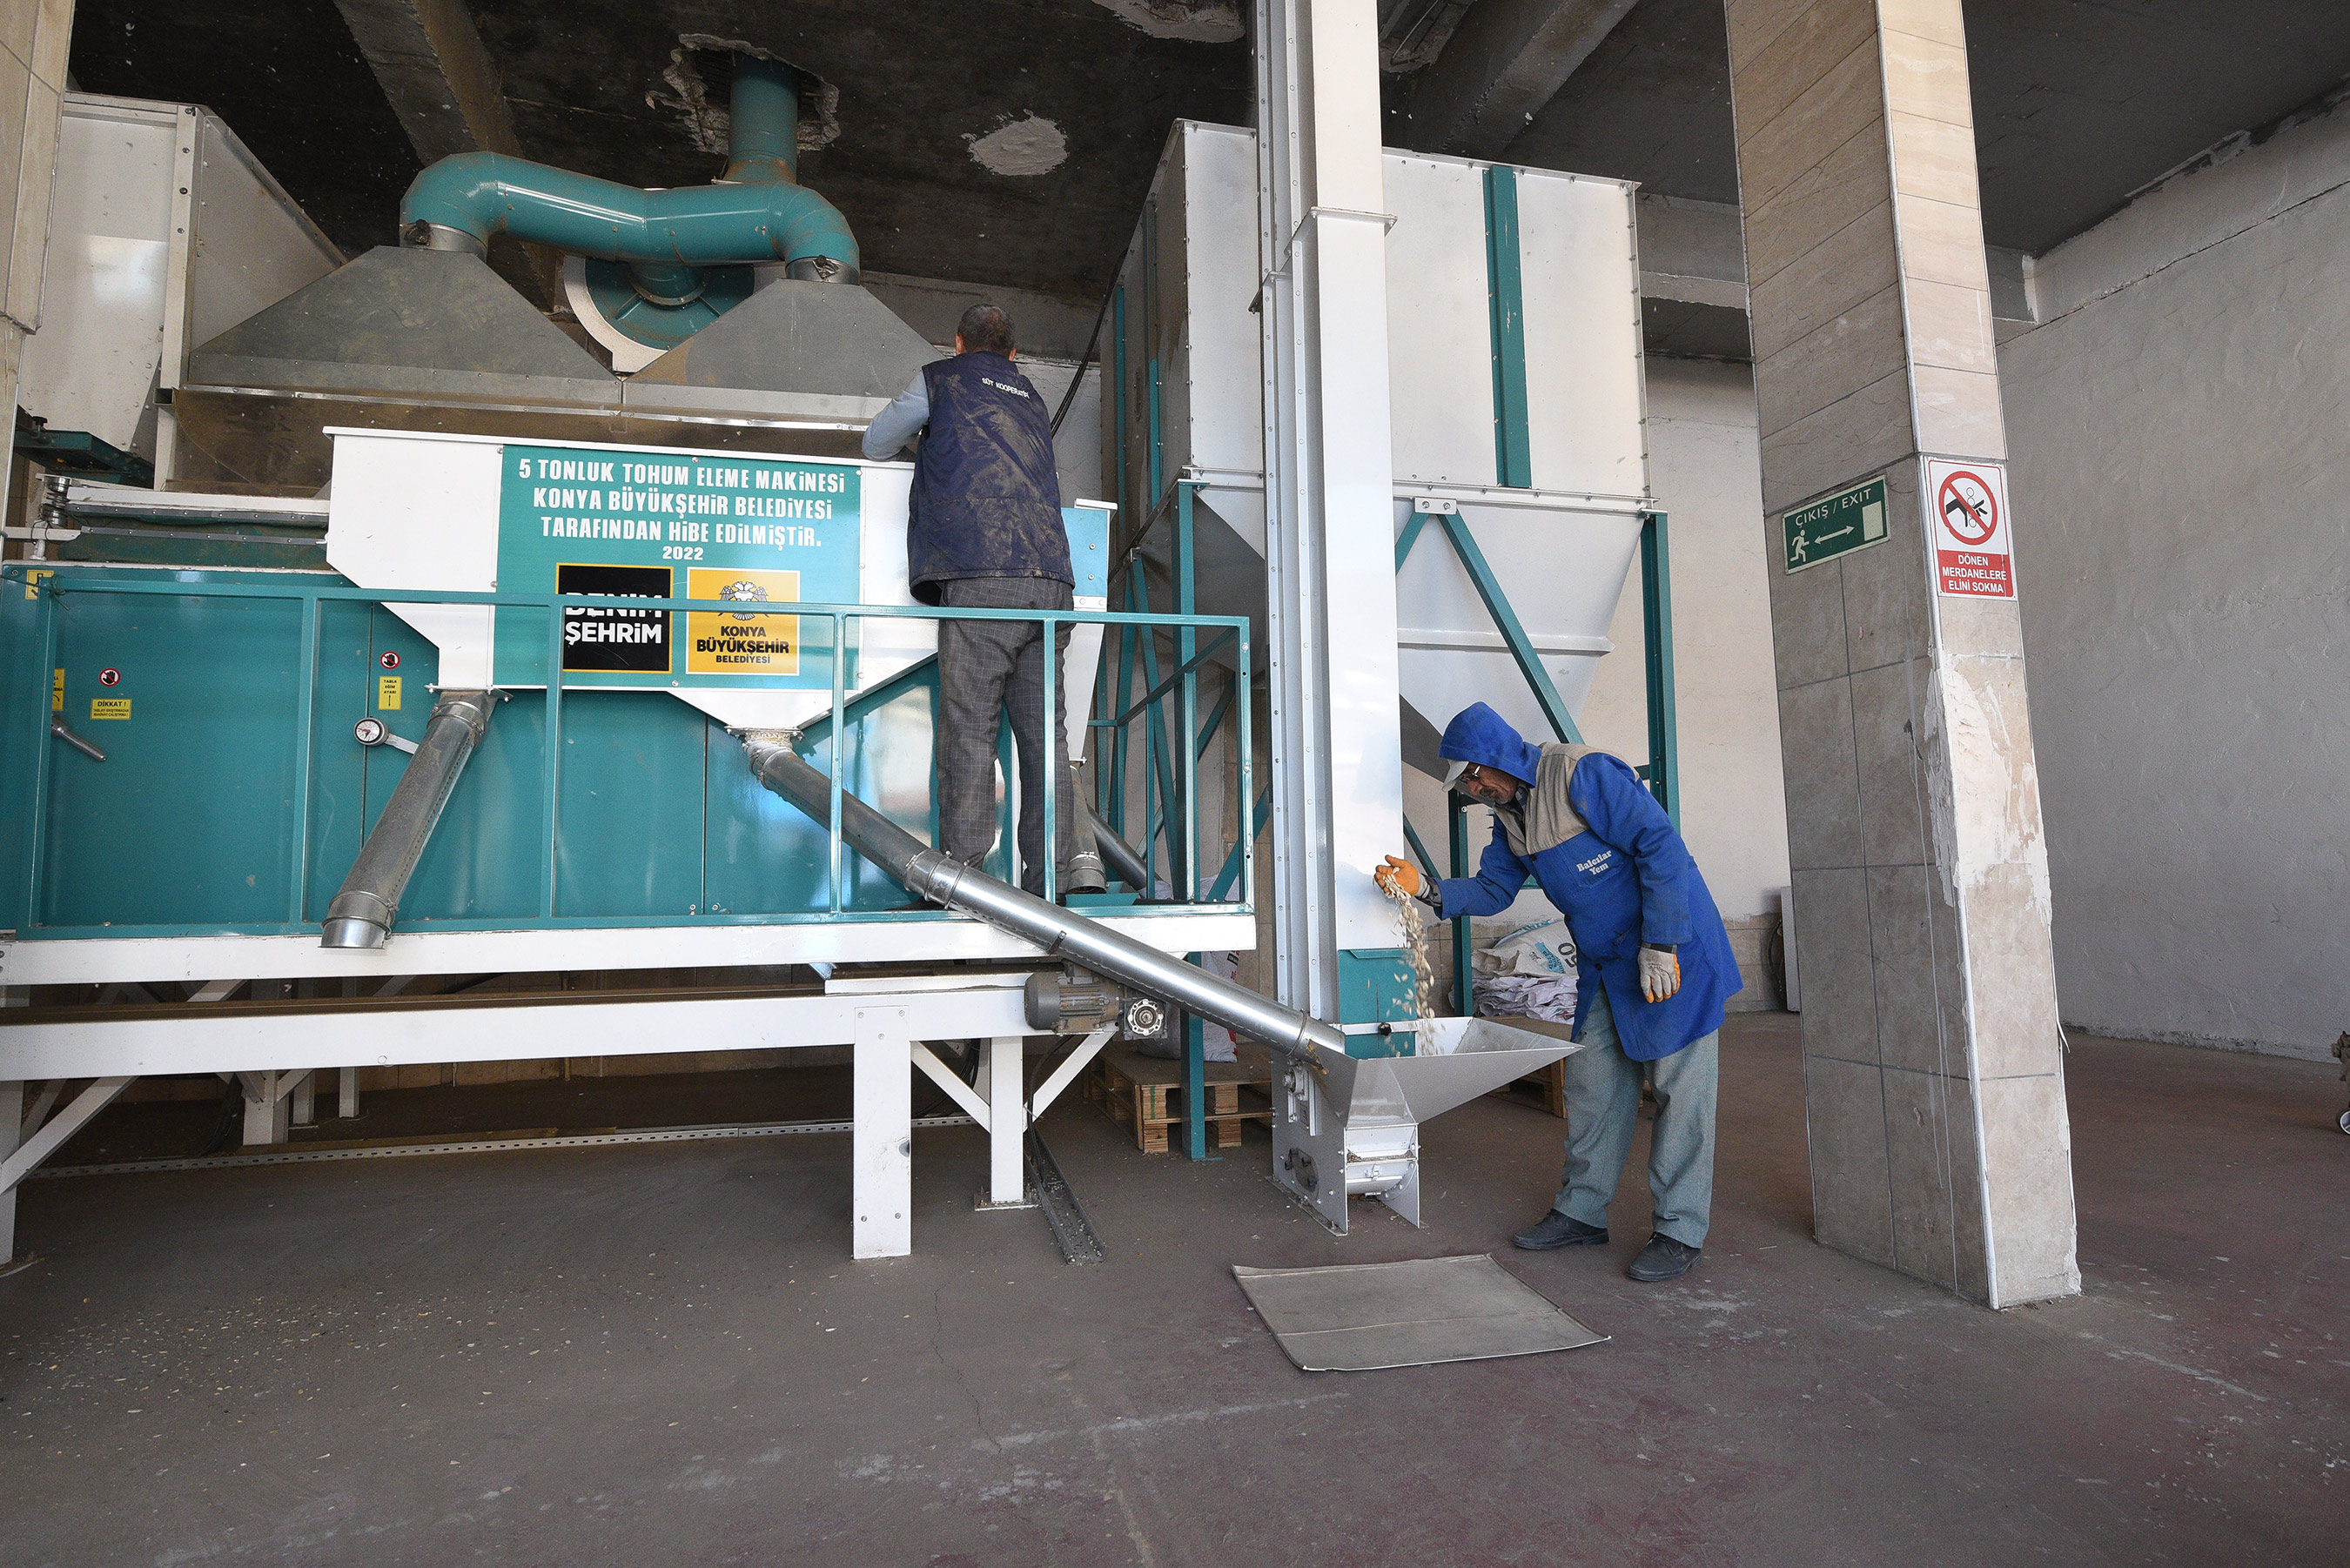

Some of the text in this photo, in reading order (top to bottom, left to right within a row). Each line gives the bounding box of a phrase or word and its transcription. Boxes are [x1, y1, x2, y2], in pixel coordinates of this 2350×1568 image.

[519, 458, 531, 479] 5
[537, 459, 614, 482] TONLUK
[622, 463, 688, 486] TOHUM
[697, 467, 749, 488] ELEME
[534, 487, 602, 510] KONYA
[1795, 487, 1871, 529] ÇIKIŞ / EXIT
[540, 516, 661, 541] TARAFINDAN
[662, 546, 704, 560] 2022
[1957, 553, 1989, 566] DÖNEN
[1942, 566, 2007, 580] MERDANELERE
[1948, 578, 2004, 593] ELİNİ SOKMA
[721, 626, 767, 637] KONYA
[696, 636, 789, 655] BÜYÜKŞEHİR
[715, 653, 770, 664] BELEDİYESİ
[1576, 850, 1612, 873] Balcılar
[1588, 862, 1609, 875] Yem
